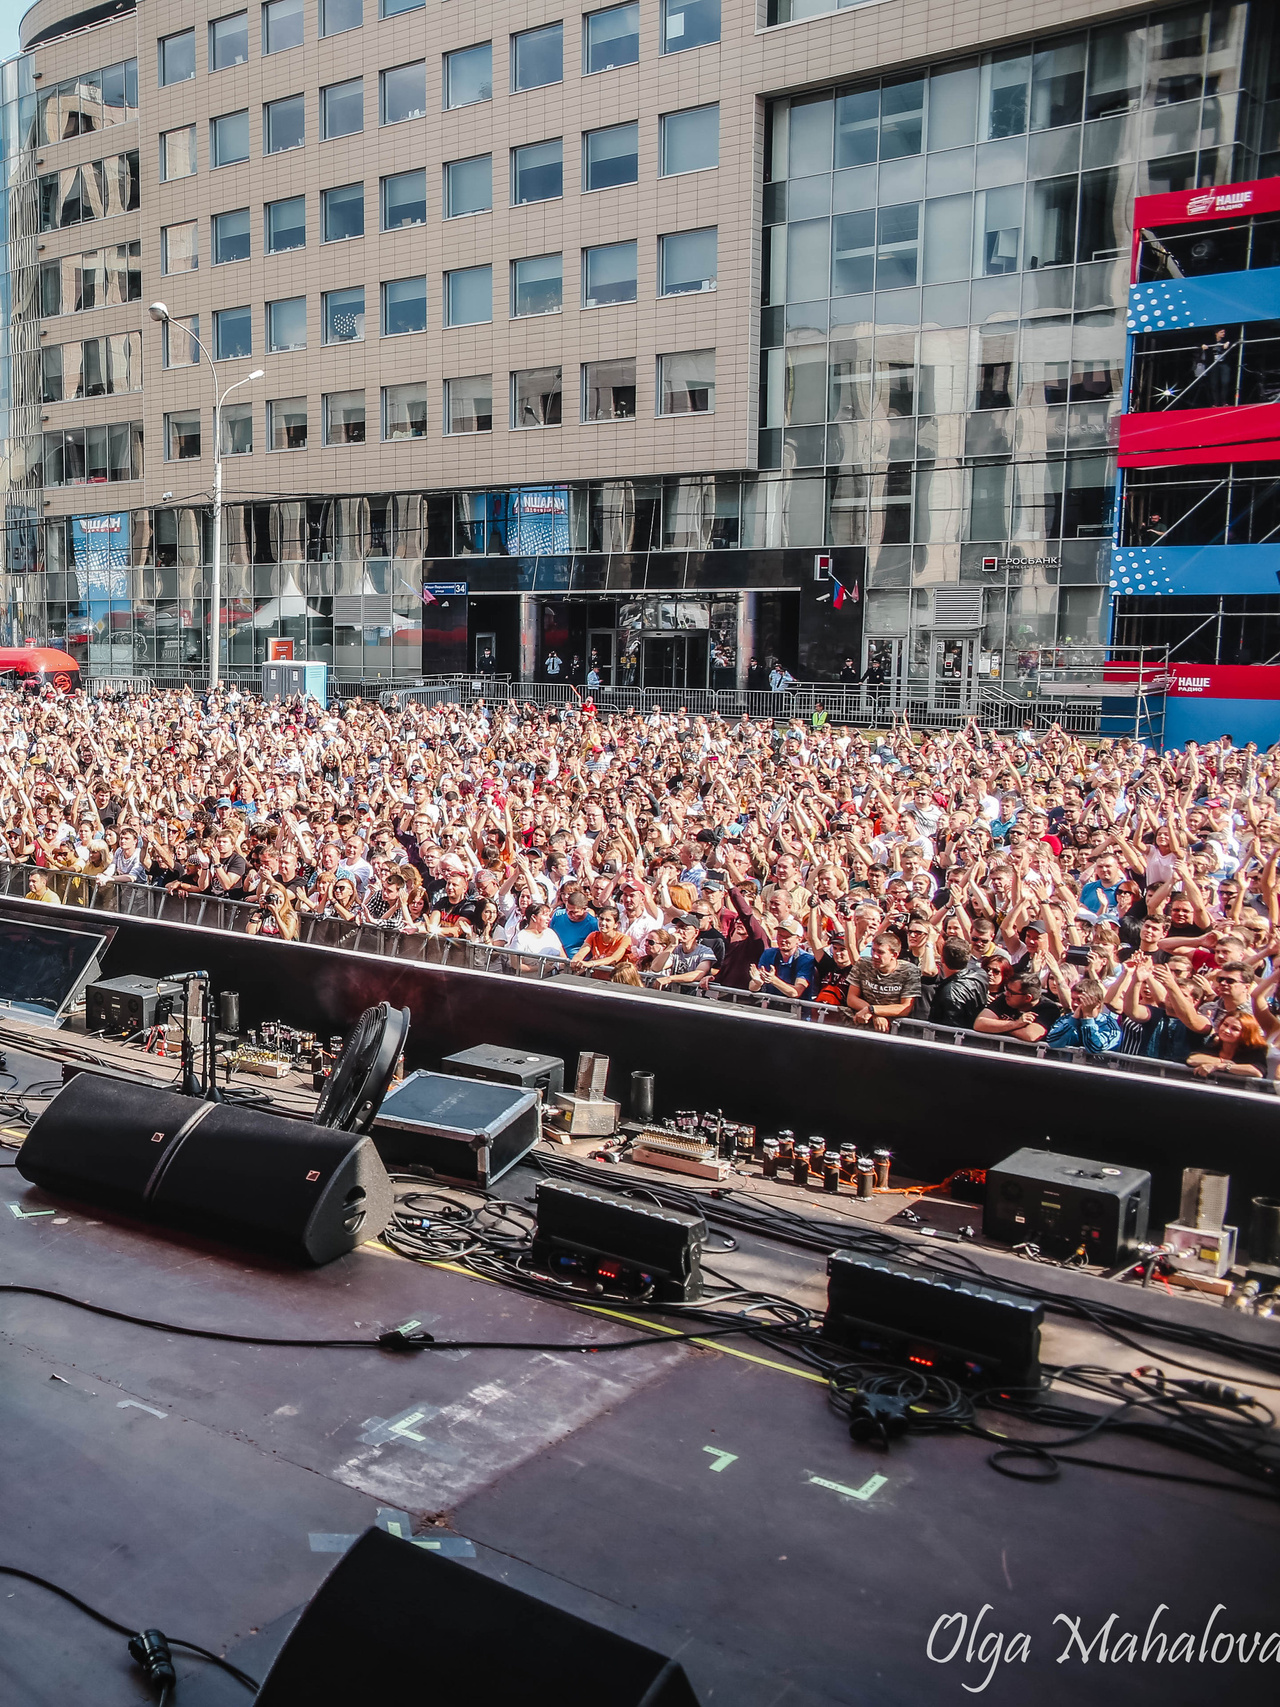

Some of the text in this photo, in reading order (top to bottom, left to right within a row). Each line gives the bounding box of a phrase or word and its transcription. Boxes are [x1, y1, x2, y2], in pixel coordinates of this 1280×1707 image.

[1216, 191, 1252, 205] НАШЕ
[1215, 203, 1244, 211] РАДИО
[1005, 557, 1058, 565] РОСБАНК
[455, 584, 465, 593] 34
[1178, 677, 1211, 687] НАШЕ
